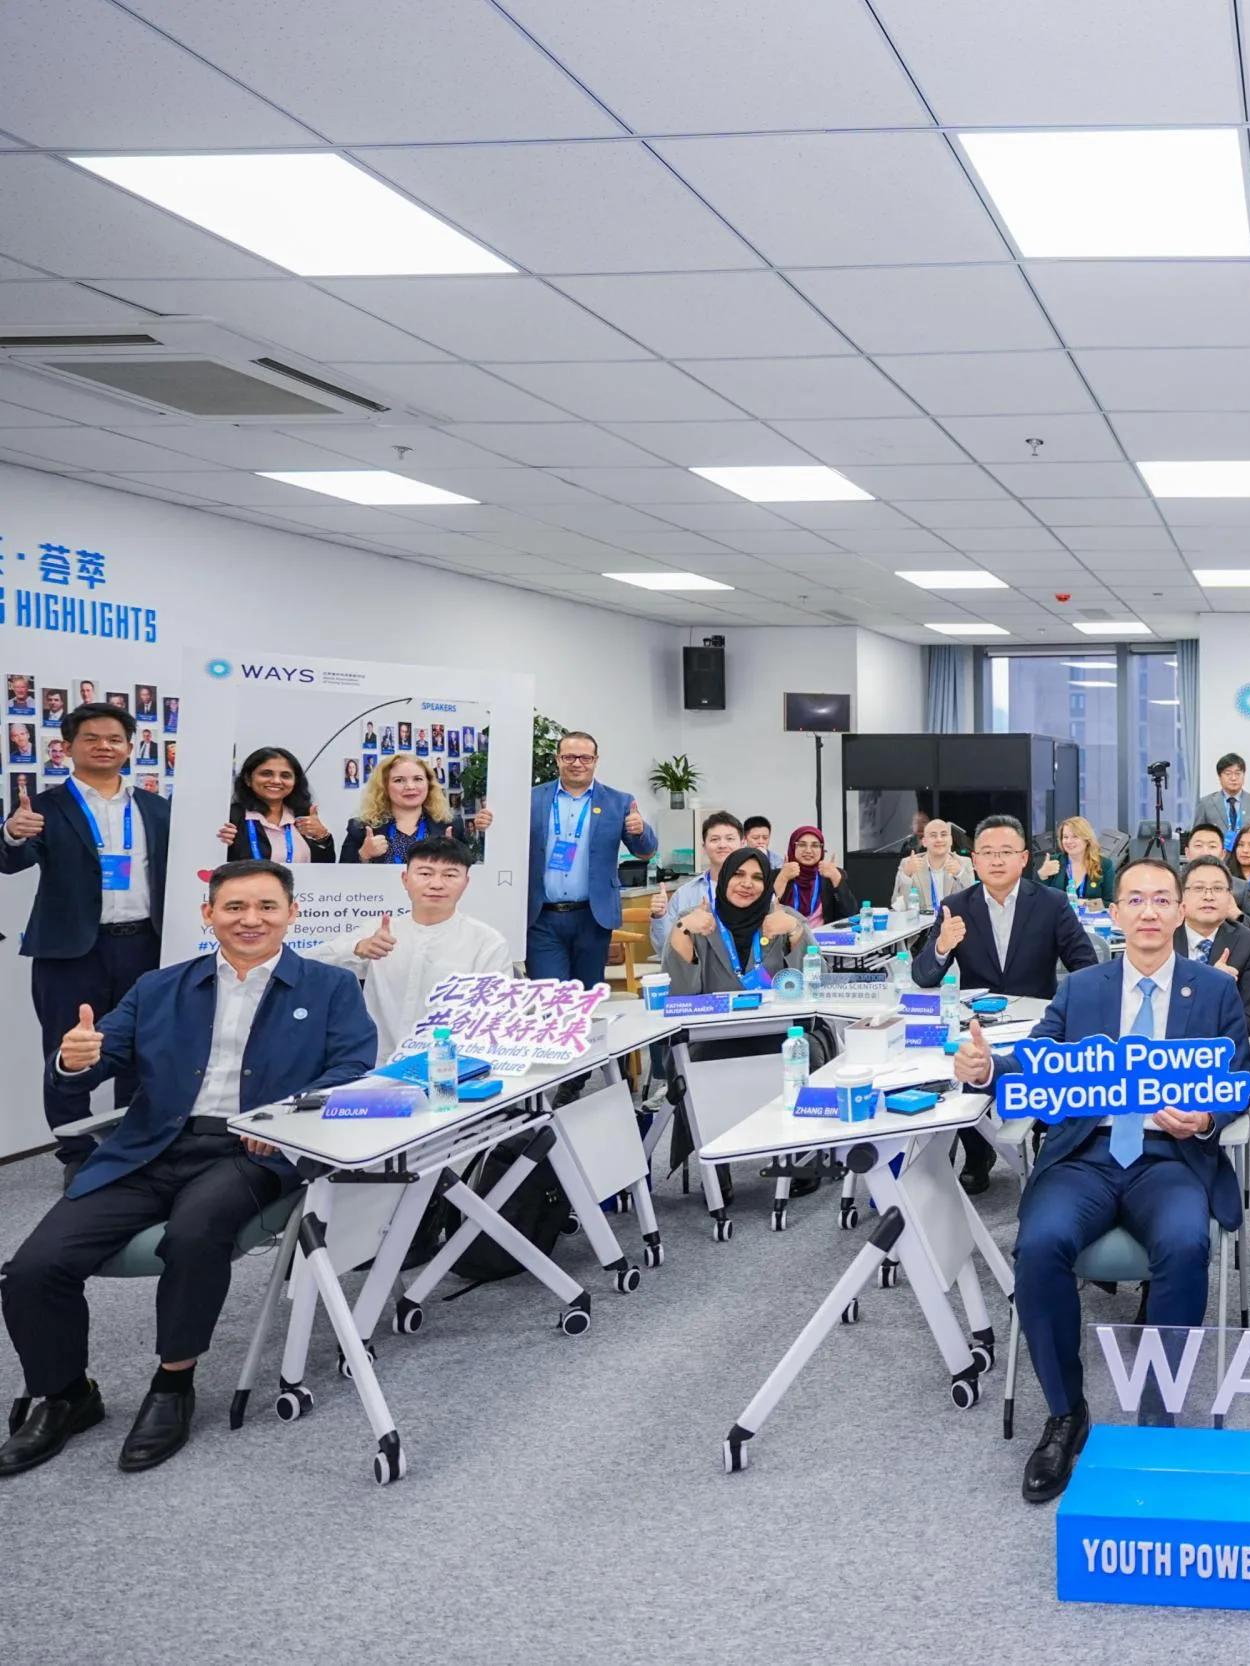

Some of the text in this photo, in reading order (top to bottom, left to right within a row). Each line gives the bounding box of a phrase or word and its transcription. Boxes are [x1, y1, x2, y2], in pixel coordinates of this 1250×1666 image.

[16, 589, 157, 643] HIGHLIGHTS
[241, 664, 315, 683] WAYS
[422, 701, 457, 713] SPEAKERS
[318, 892, 343, 902] and
[346, 892, 384, 902] others
[334, 907, 348, 917] of
[294, 924, 341, 936] Beyond
[429, 975, 605, 1018] 汇聚天下英才
[415, 1008, 586, 1053] 共创美好未来
[532, 1047, 571, 1060] Talents
[1023, 1044, 1226, 1074] Youth Power
[1005, 1075, 1246, 1115] Beyond Border
[339, 1107, 368, 1116] BOJUN
[795, 1106, 822, 1115] ZHANG
[1082, 1538, 1171, 1577] YOUTH
